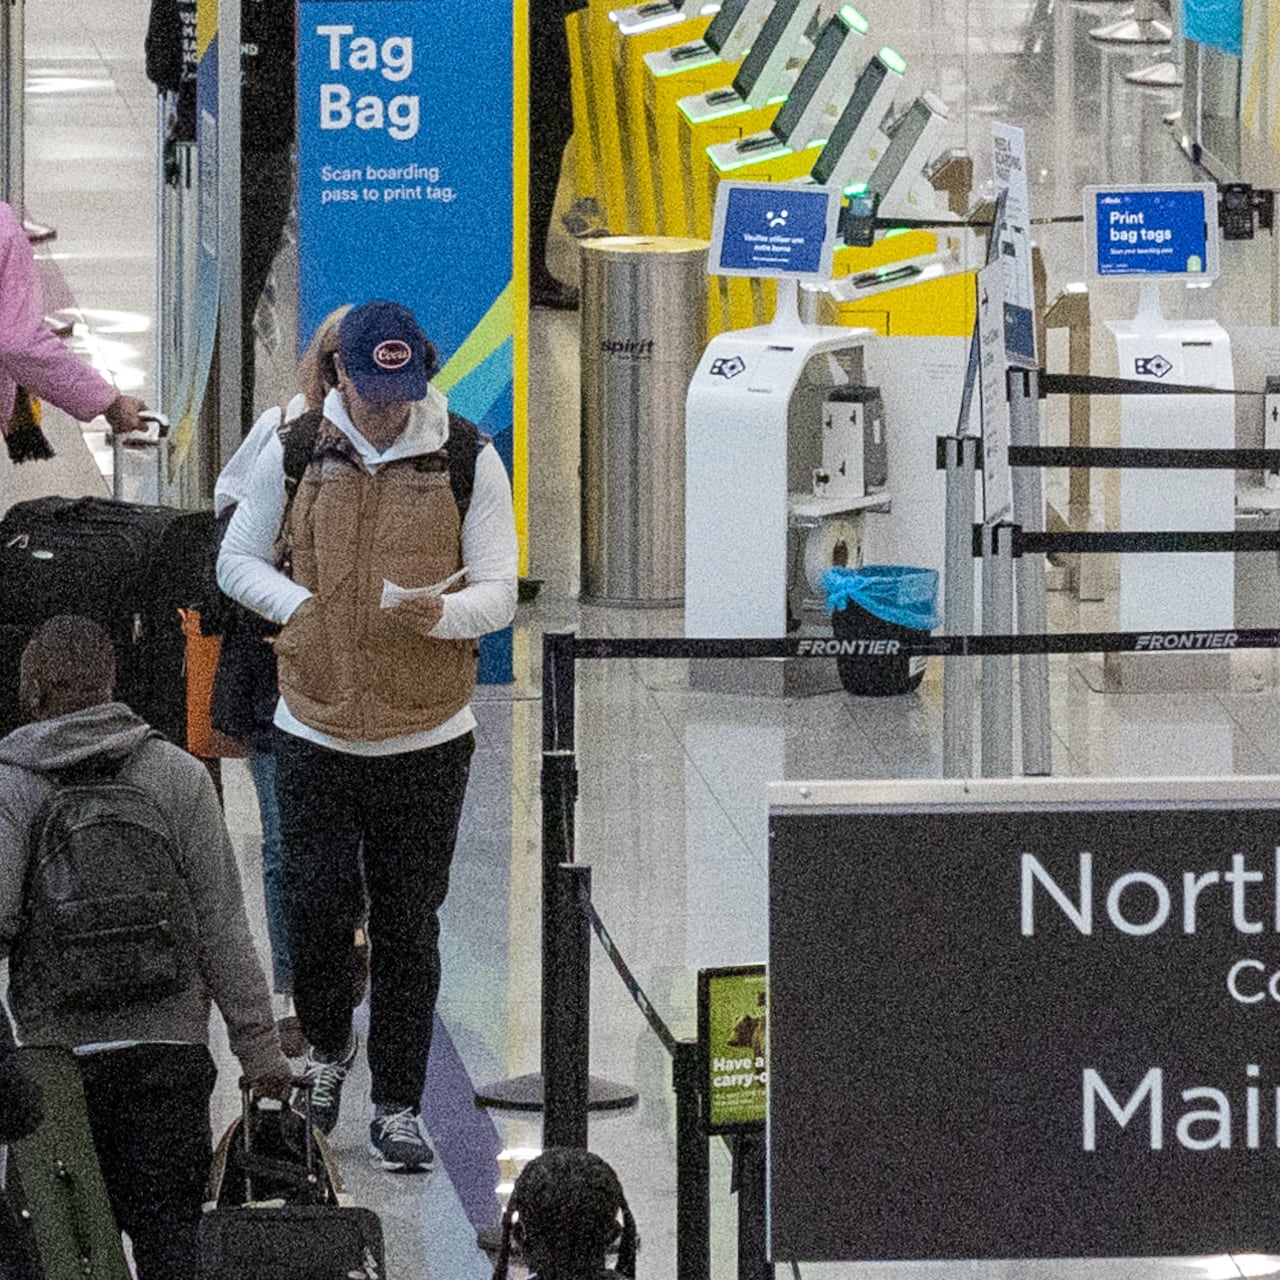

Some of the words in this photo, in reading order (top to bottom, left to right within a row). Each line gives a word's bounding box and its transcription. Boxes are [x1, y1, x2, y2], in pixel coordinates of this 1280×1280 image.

[316, 24, 413, 82] Tag
[320, 83, 420, 141] Bag
[321, 166, 362, 182] Scan
[366, 164, 440, 183] boarding
[322, 190, 359, 204] pass
[363, 188, 380, 201] to
[383, 186, 423, 202] print
[427, 187, 458, 203] tag.
[1110, 211, 1145, 225] Print
[1110, 228, 1138, 245] bag
[1140, 228, 1173, 244] tags
[601, 339, 654, 354] spirit
[798, 639, 901, 656] FRONTIER
[1135, 632, 1238, 651] FRONTIER
[714, 1057, 751, 1071] Have
[754, 1059, 764, 1068] a
